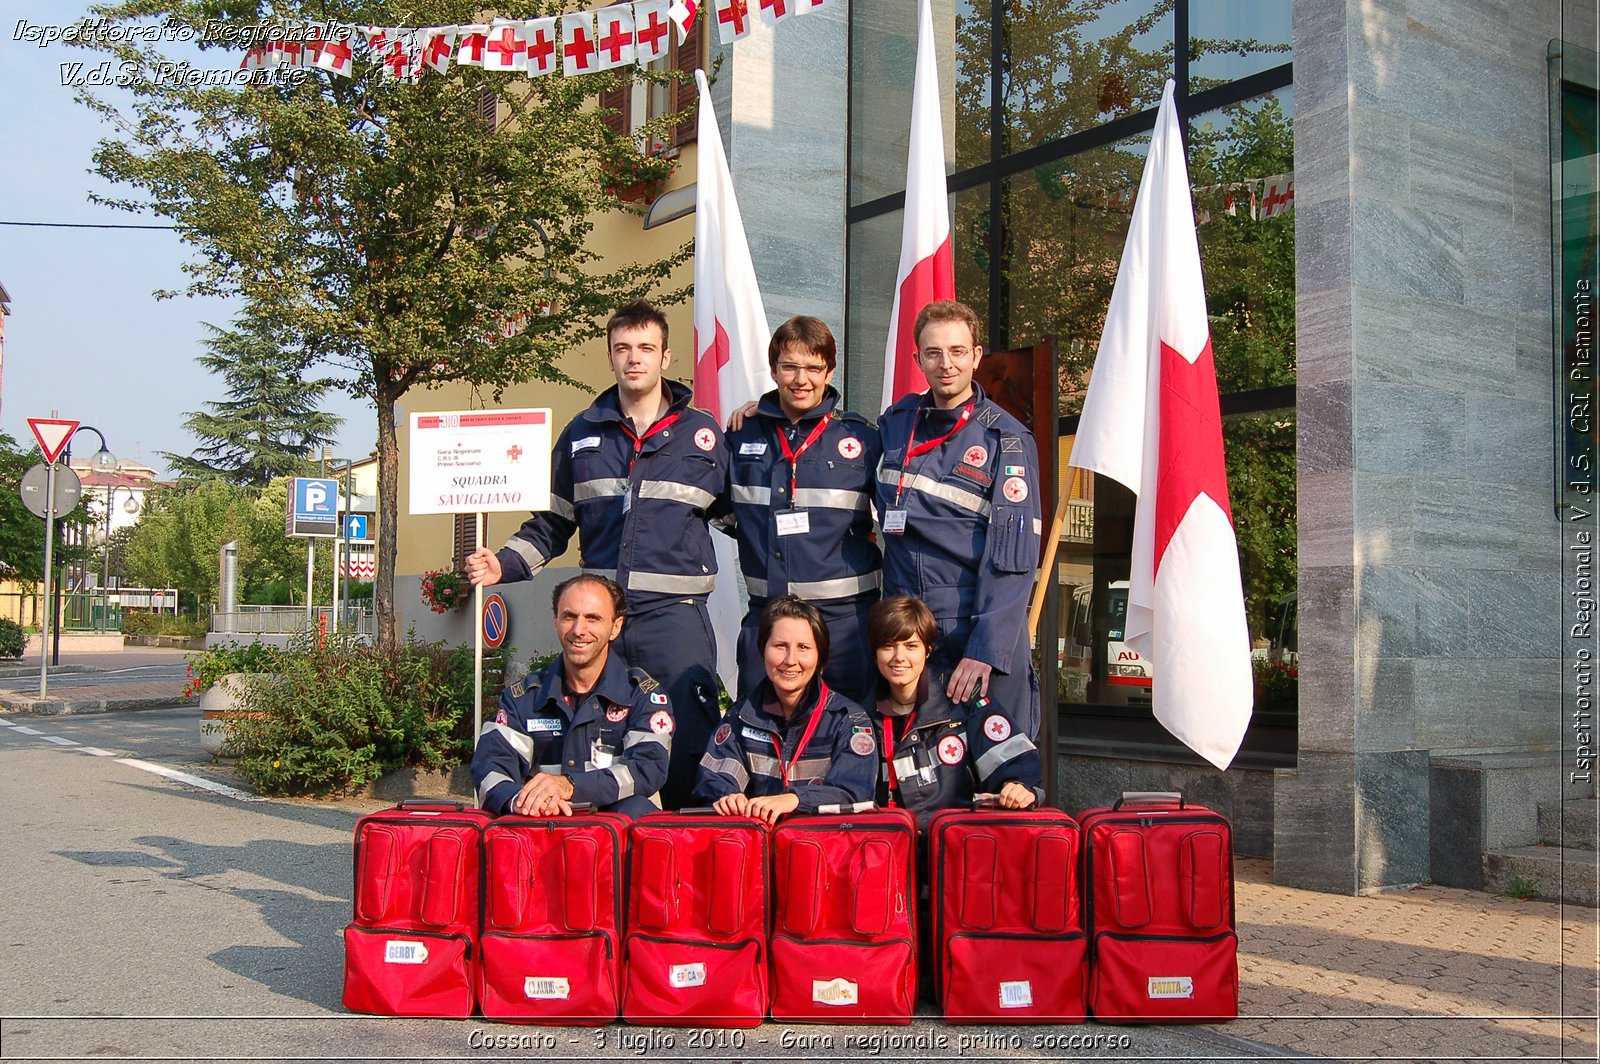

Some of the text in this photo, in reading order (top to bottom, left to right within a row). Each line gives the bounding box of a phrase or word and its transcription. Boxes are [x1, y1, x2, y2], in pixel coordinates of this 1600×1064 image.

[451, 474, 508, 488] SQUADRA
[306, 488, 326, 511] P
[438, 491, 522, 506] SAVIGLIANO
[388, 945, 416, 959] GERBY
[528, 980, 556, 995] CLAUDE
[1004, 985, 1023, 1001] TATO
[1151, 980, 1182, 994] PATATA
